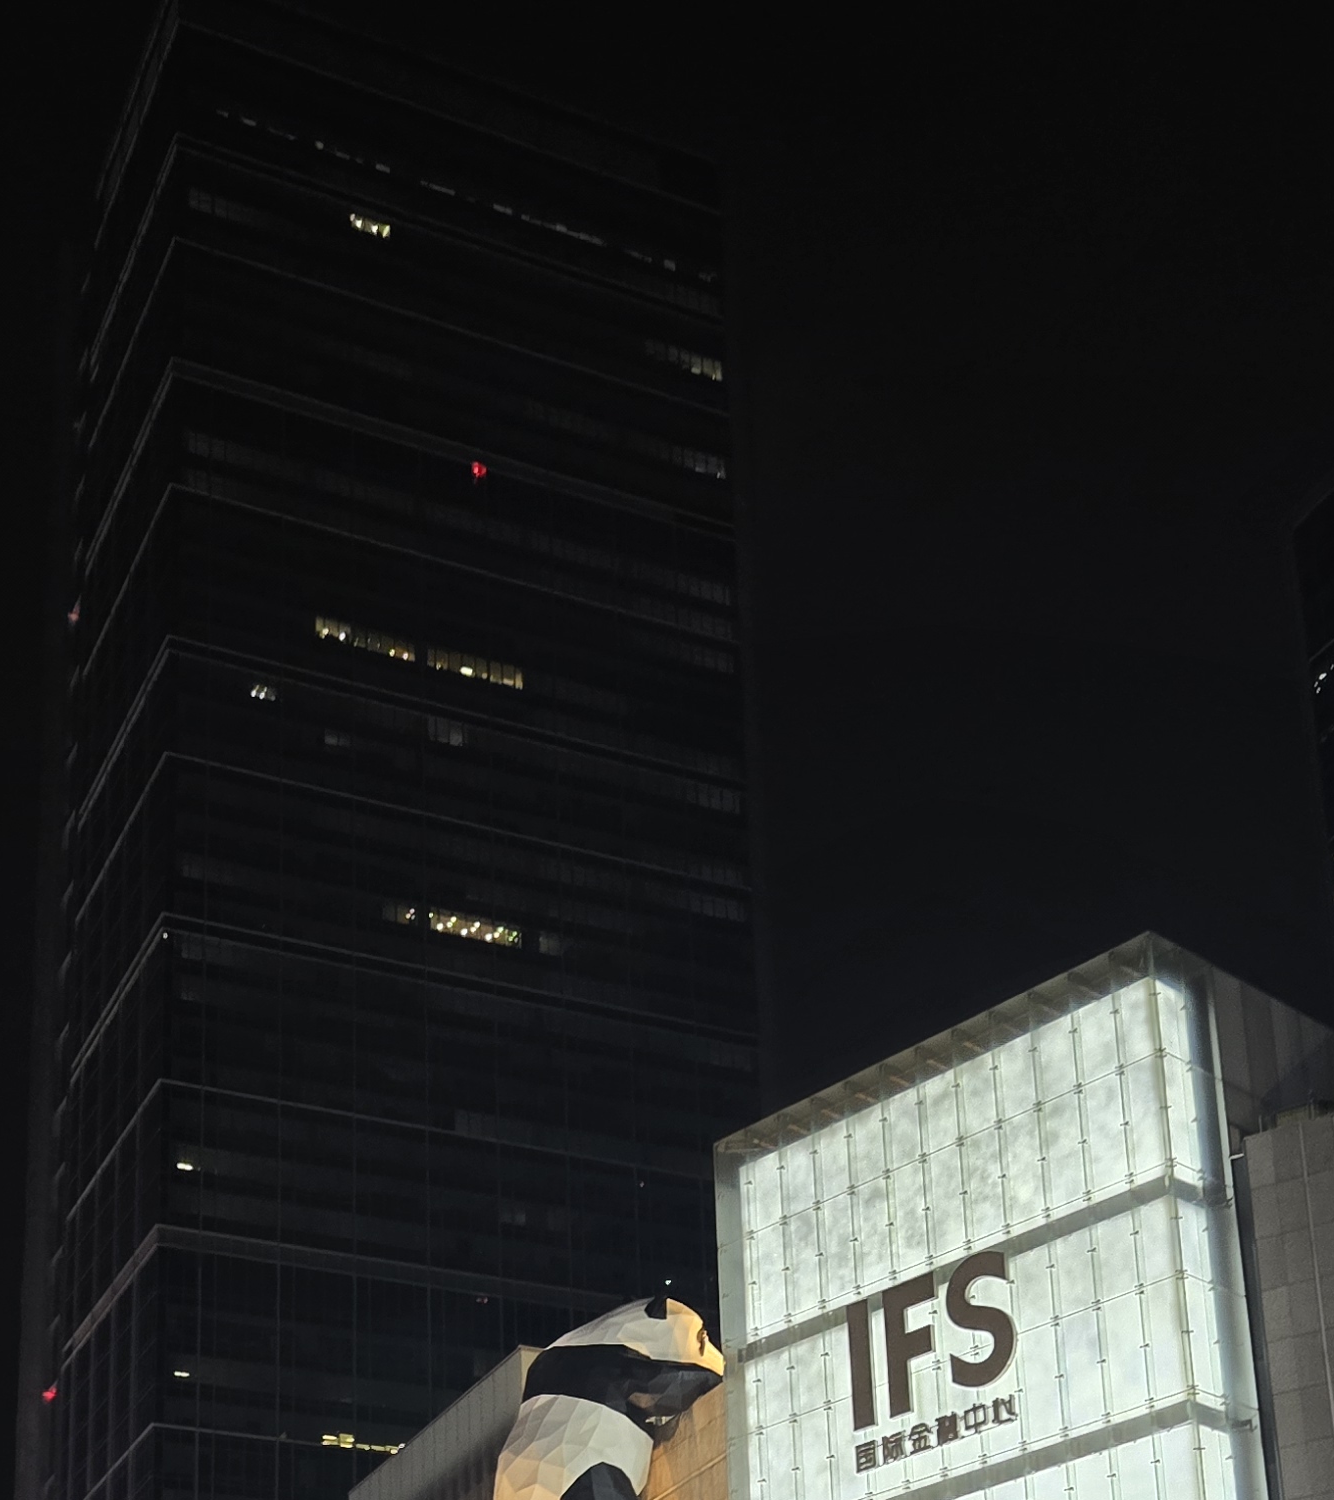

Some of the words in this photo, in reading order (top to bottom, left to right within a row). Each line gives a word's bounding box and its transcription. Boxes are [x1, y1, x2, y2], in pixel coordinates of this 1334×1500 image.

[847, 1250, 1017, 1431] IFS
[855, 1394, 1018, 1474] 国际金融中心
